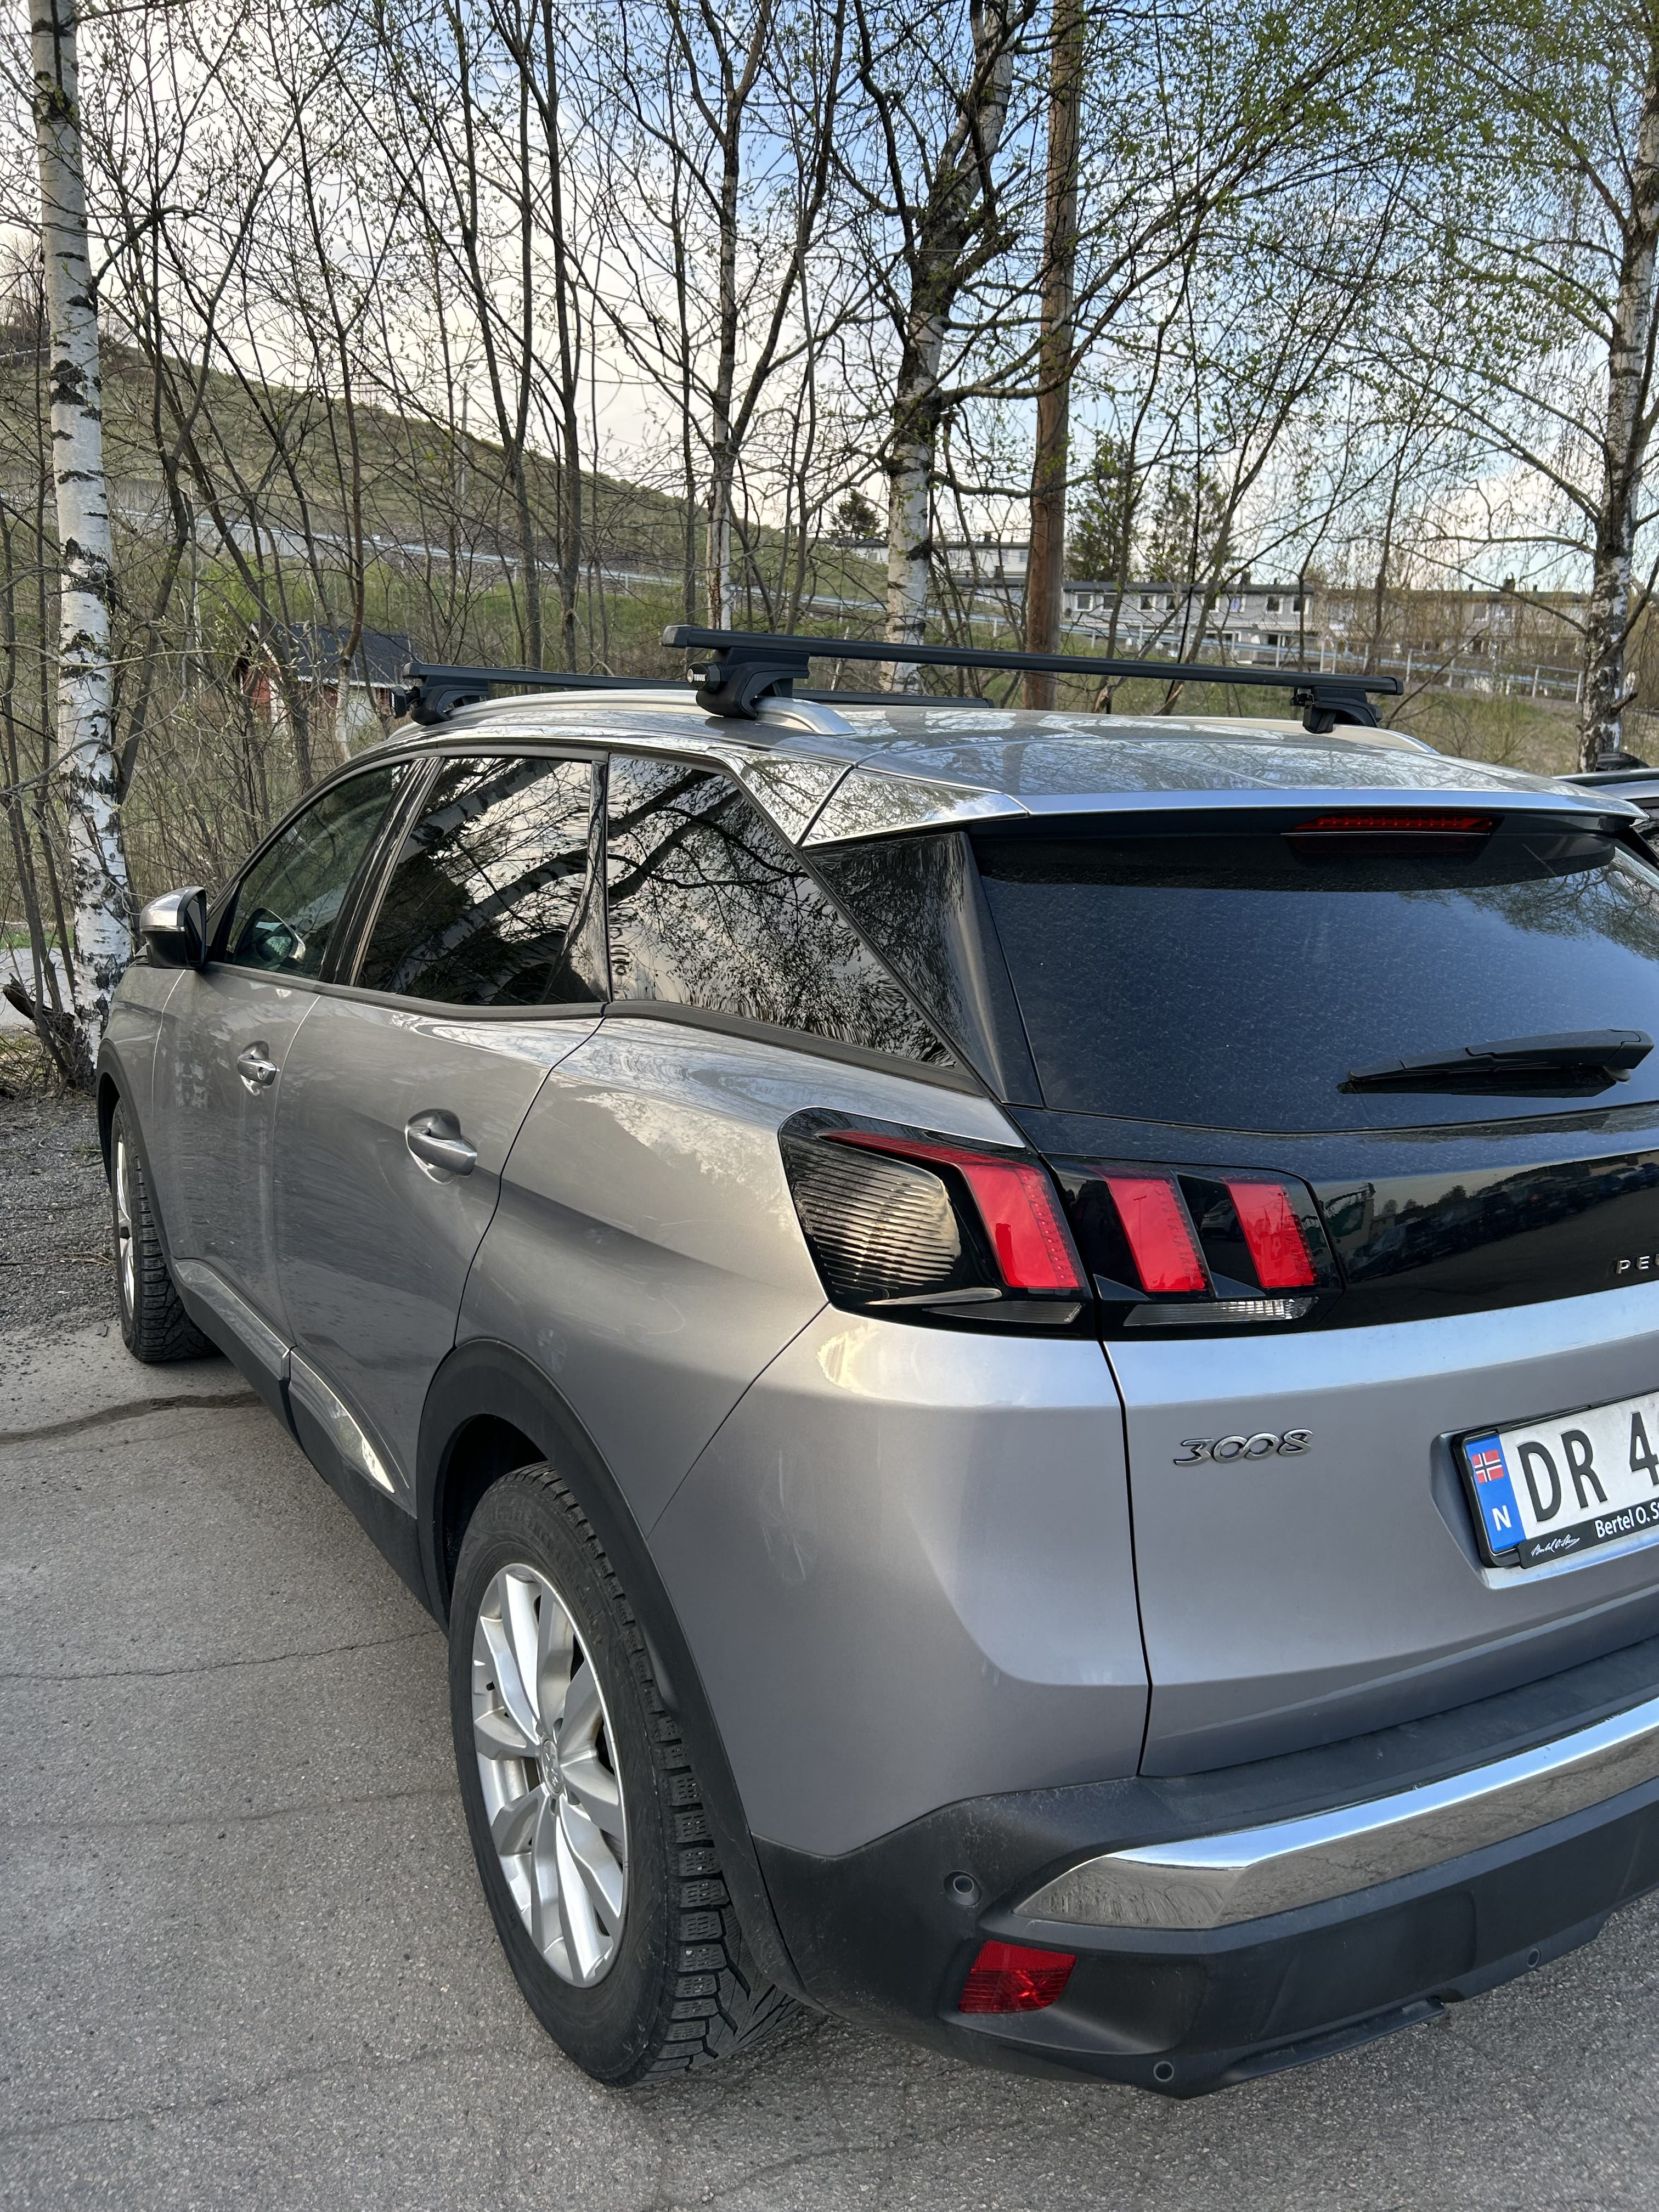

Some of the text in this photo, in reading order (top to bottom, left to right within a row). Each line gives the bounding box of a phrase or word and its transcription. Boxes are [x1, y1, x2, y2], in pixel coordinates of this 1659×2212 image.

[1173, 1428, 1313, 1466] 3008
[1517, 1429, 1608, 1522] DR
[1492, 1505, 1512, 1531] N
[1595, 1502, 1659, 1538] Bertel O. S
